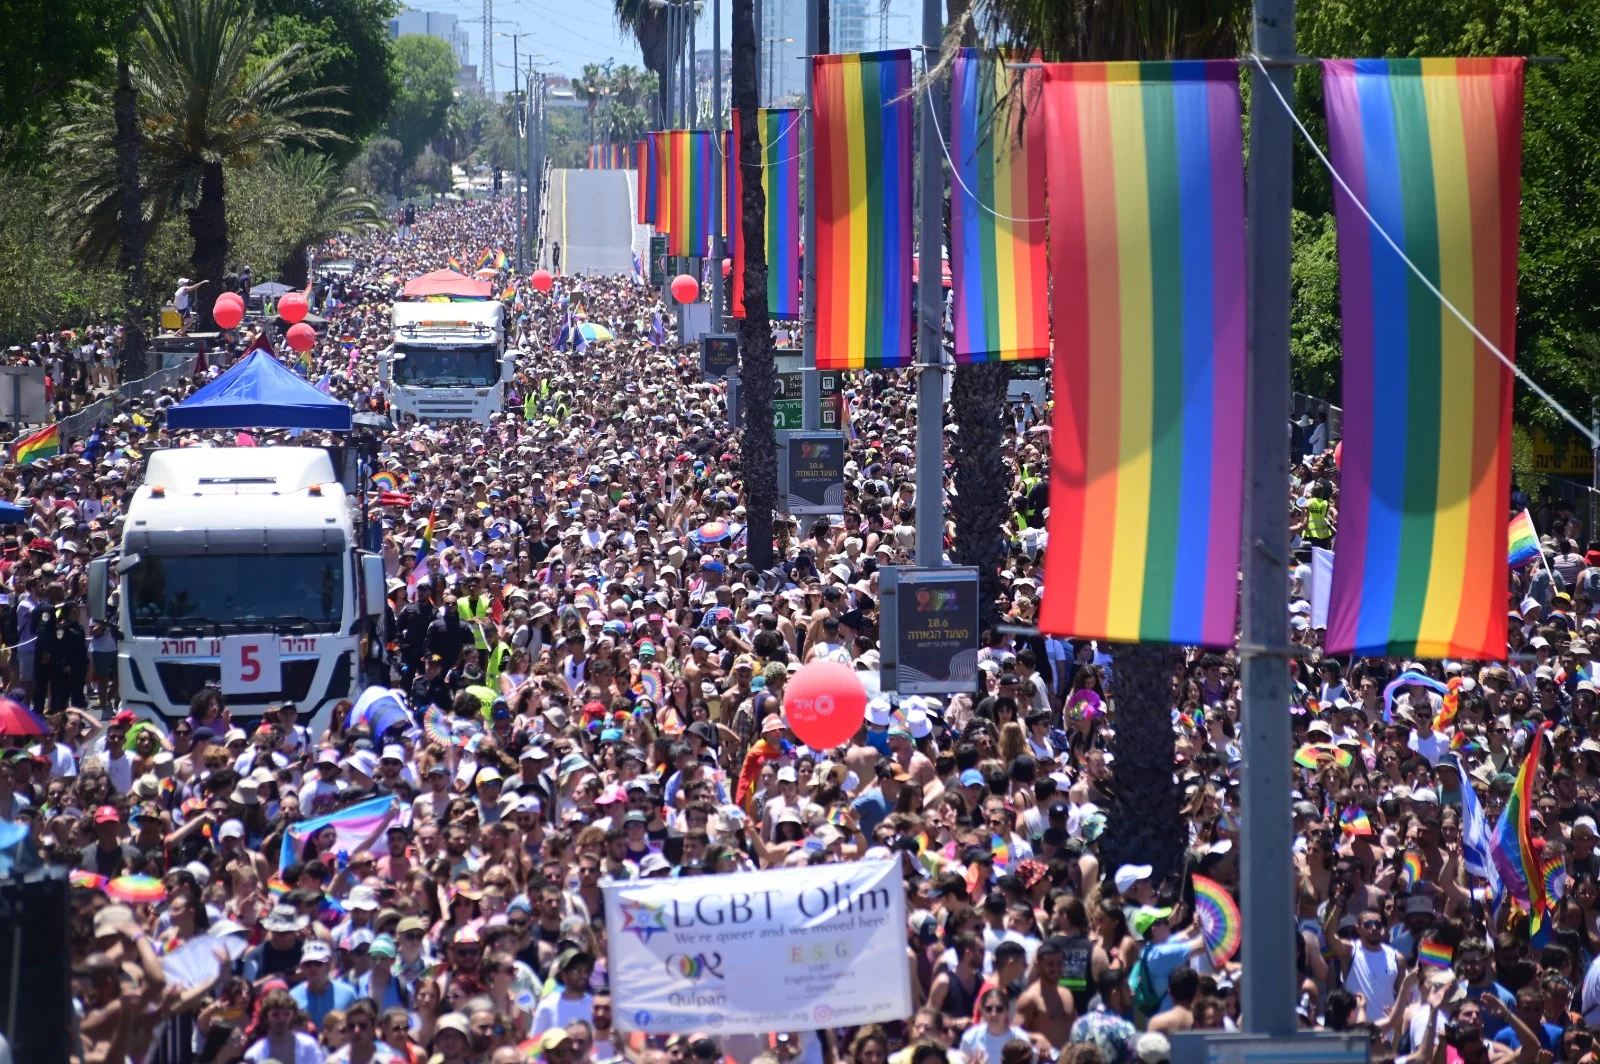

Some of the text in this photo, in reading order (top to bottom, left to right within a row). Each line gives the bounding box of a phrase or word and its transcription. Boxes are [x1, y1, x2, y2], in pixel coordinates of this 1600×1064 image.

[928, 619, 948, 627] 10.6
[908, 629, 968, 640] מצעד הגאווה
[161, 641, 196, 655] חורג
[240, 645, 261, 682] 5
[672, 882, 890, 928] LGBT Olim
[675, 914, 890, 944] We're queer and we moved here!
